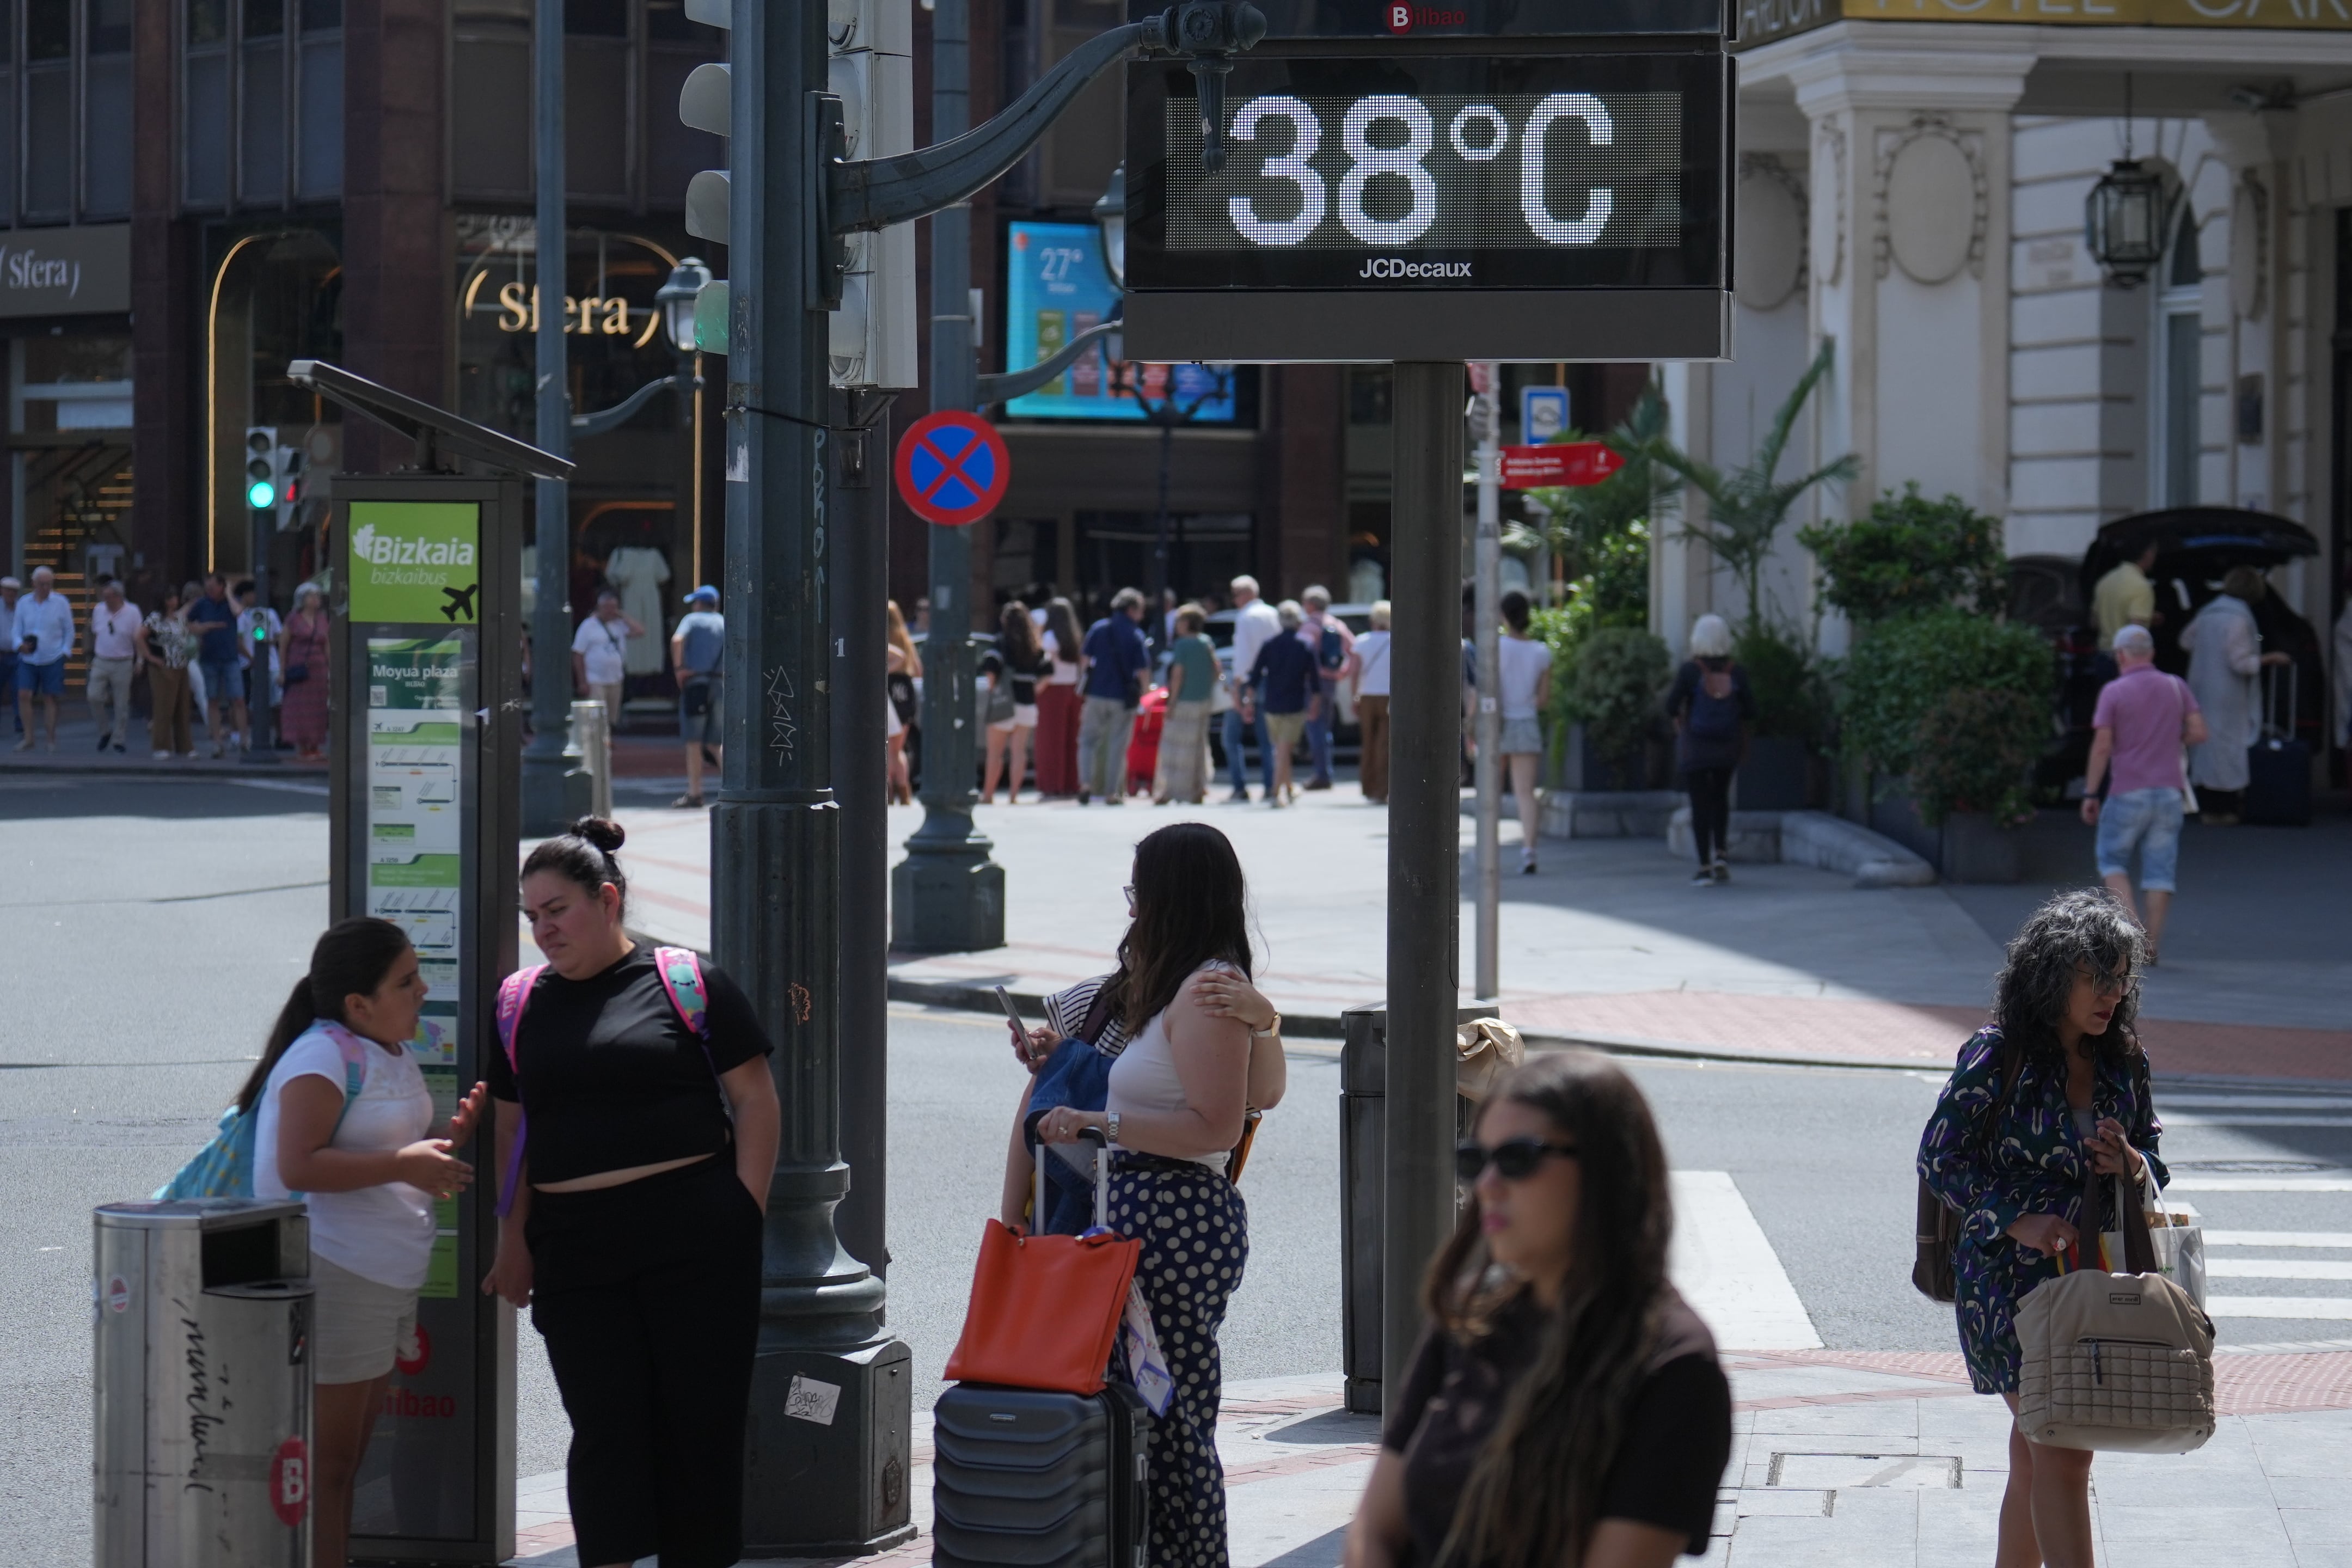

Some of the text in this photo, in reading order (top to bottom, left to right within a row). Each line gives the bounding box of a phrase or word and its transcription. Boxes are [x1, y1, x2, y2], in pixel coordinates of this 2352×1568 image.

[1393, 7, 1466, 27] Bilbao
[1229, 94, 1613, 245] 38°C
[1040, 248, 1083, 281] 27°
[1359, 258, 1472, 278] JCDecaux
[372, 536, 475, 566] Bizkaia
[370, 567, 449, 585] bizkaibus
[372, 665, 458, 680] Moyua plaza
